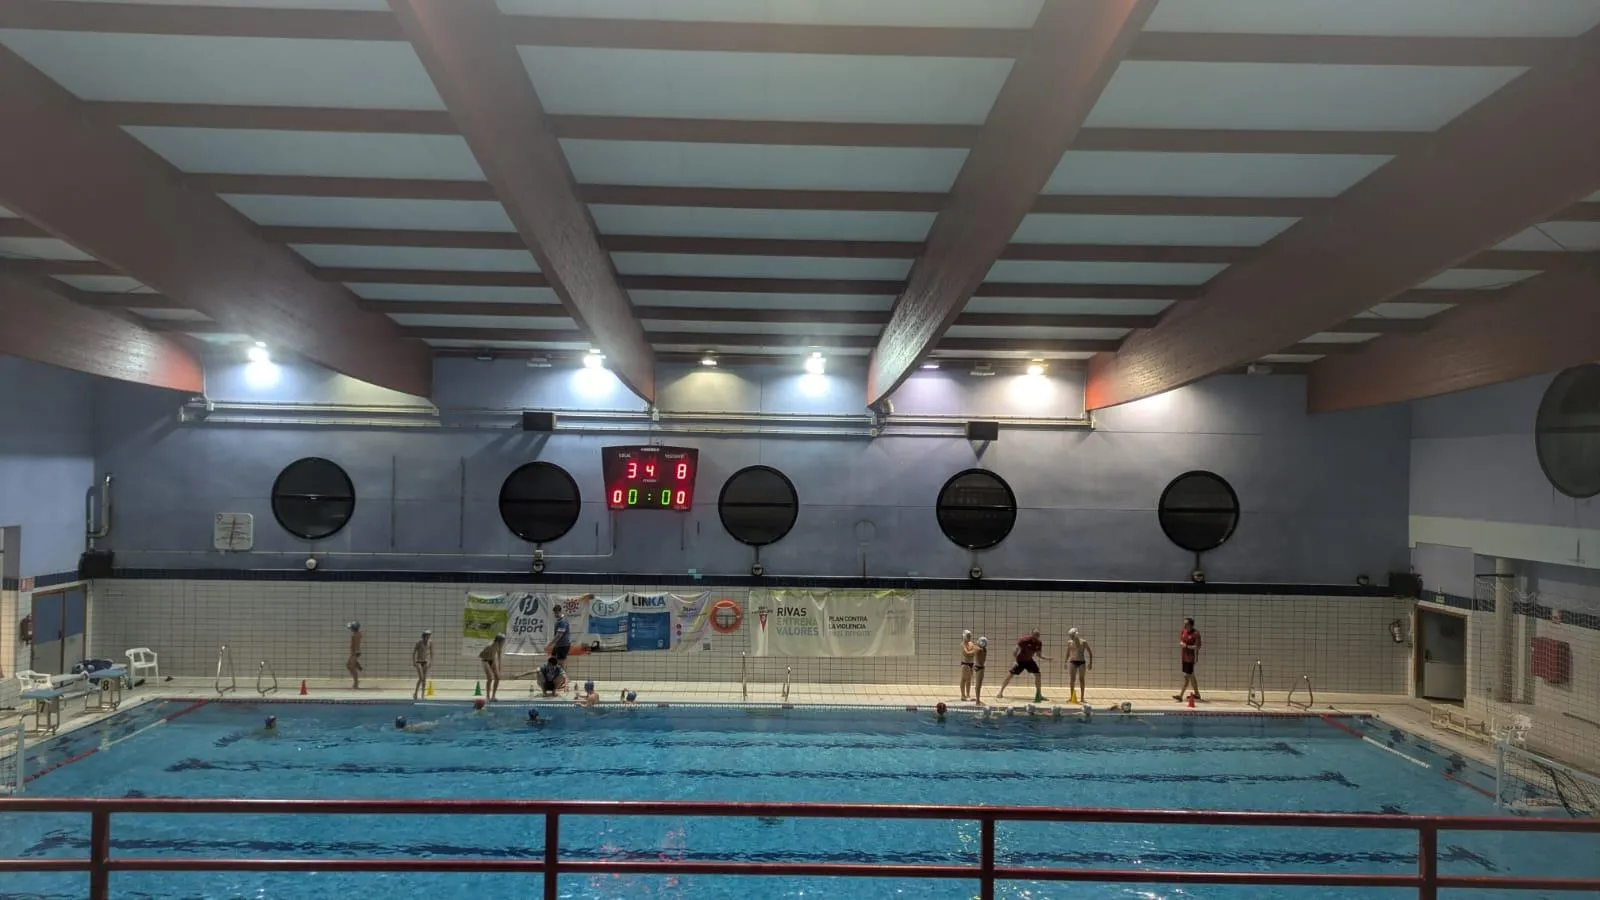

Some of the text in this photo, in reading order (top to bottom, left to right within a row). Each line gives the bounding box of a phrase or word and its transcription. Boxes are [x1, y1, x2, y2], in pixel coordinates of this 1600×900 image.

[628, 463, 687, 479] 3 4 8
[777, 607, 807, 617] RIVAS
[513, 624, 543, 635] sport
[776, 627, 819, 636] VALORES
[103, 680, 109, 691] 8
